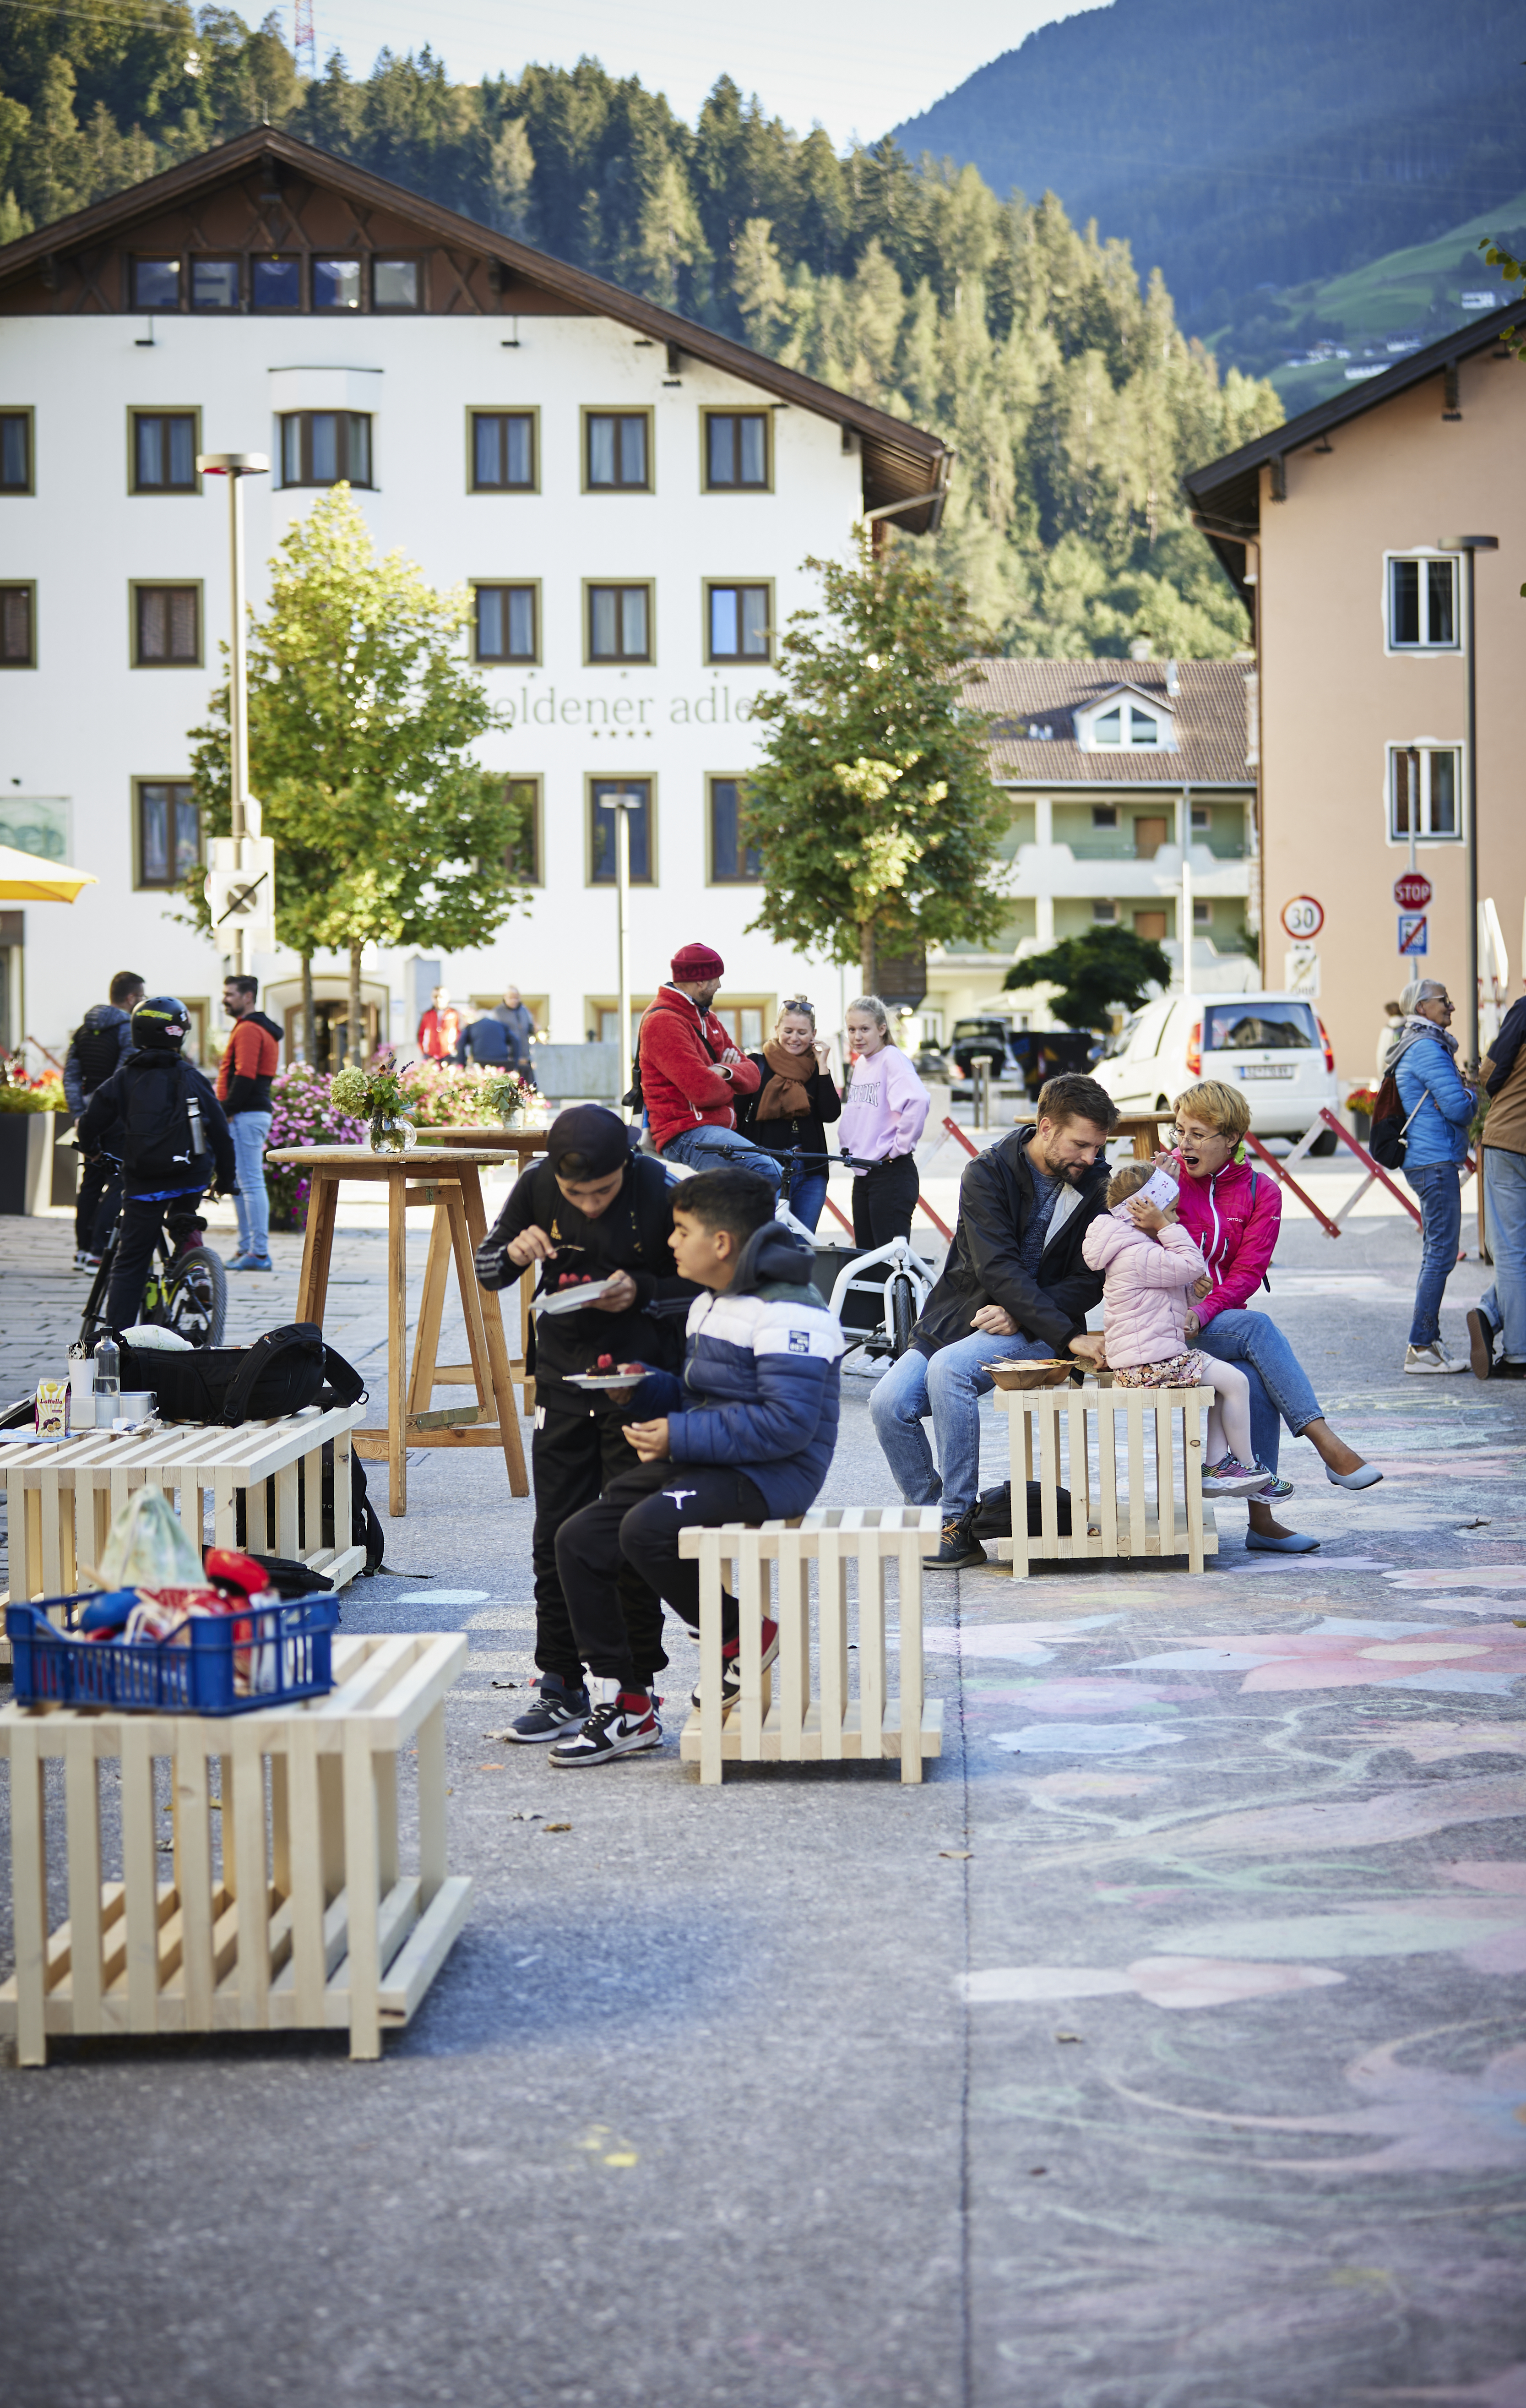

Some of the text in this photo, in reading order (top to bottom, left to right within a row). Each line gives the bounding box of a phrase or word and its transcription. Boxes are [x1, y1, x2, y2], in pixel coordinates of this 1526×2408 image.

[488, 685, 754, 725] oldener adle
[1395, 883, 1431, 902] STOP
[1292, 907, 1314, 929] 30
